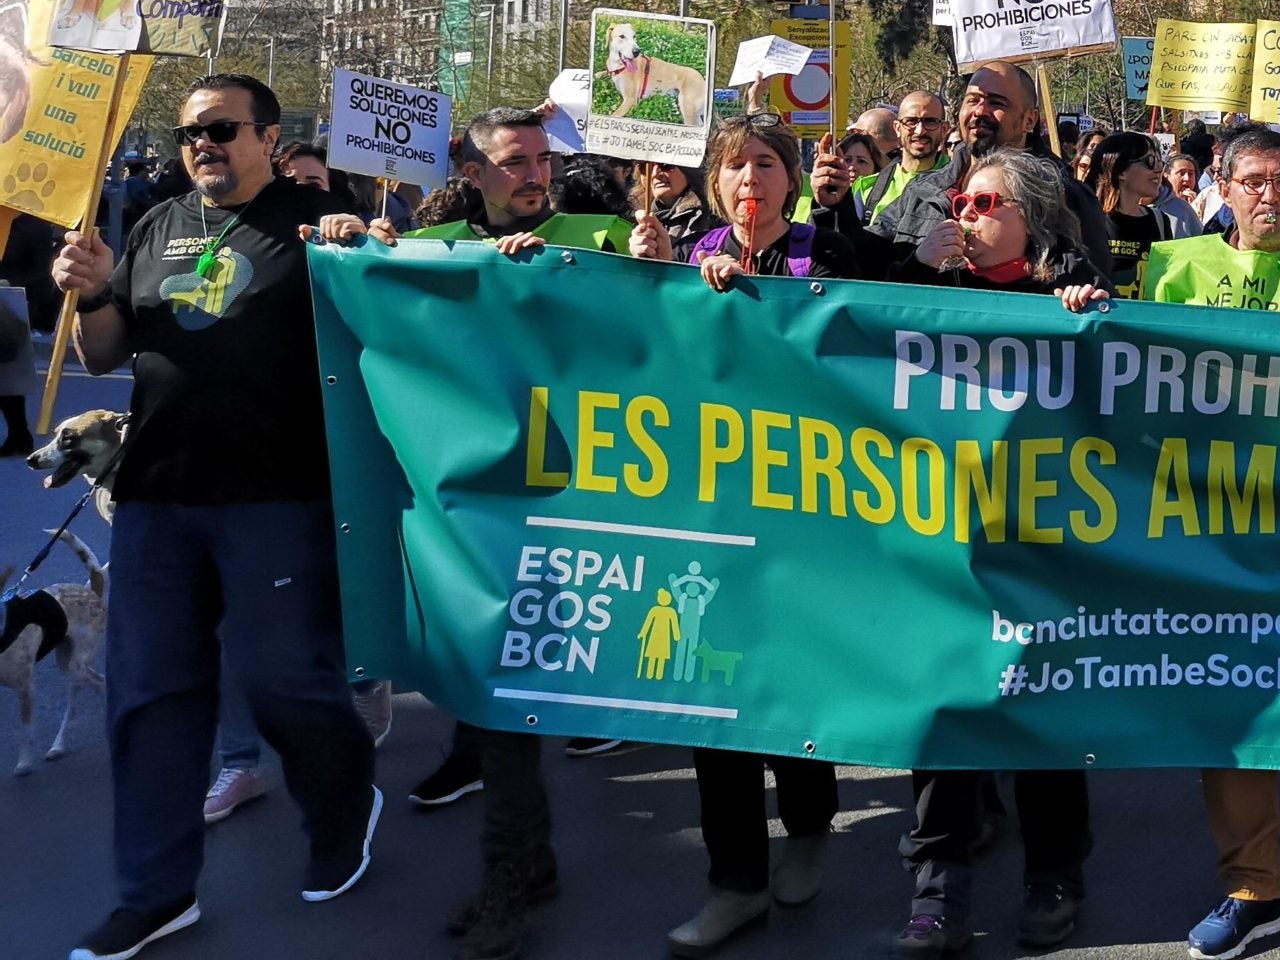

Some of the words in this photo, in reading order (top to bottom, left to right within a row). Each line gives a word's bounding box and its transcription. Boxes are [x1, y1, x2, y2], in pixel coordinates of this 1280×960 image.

[962, 0, 1092, 32] PROHIBICIONES
[56, 73, 65, 88] i
[68, 80, 101, 100] vull
[350, 78, 438, 113] QUEREMOS
[44, 104, 77, 125] una
[349, 96, 437, 128] SOLUCIONES
[24, 129, 86, 159] solució
[374, 116, 411, 145] NO
[346, 134, 436, 164] PROHIBICIONES
[163, 247, 186, 255] AMB
[1216, 274, 1232, 287] A
[1242, 276, 1266, 295] MI
[893, 330, 1076, 412] PROU
[526, 386, 671, 498] LES
[698, 401, 1118, 544] PERSONES
[517, 546, 645, 592] ESPAI
[509, 588, 613, 631] GOS
[500, 630, 600, 675] BCN
